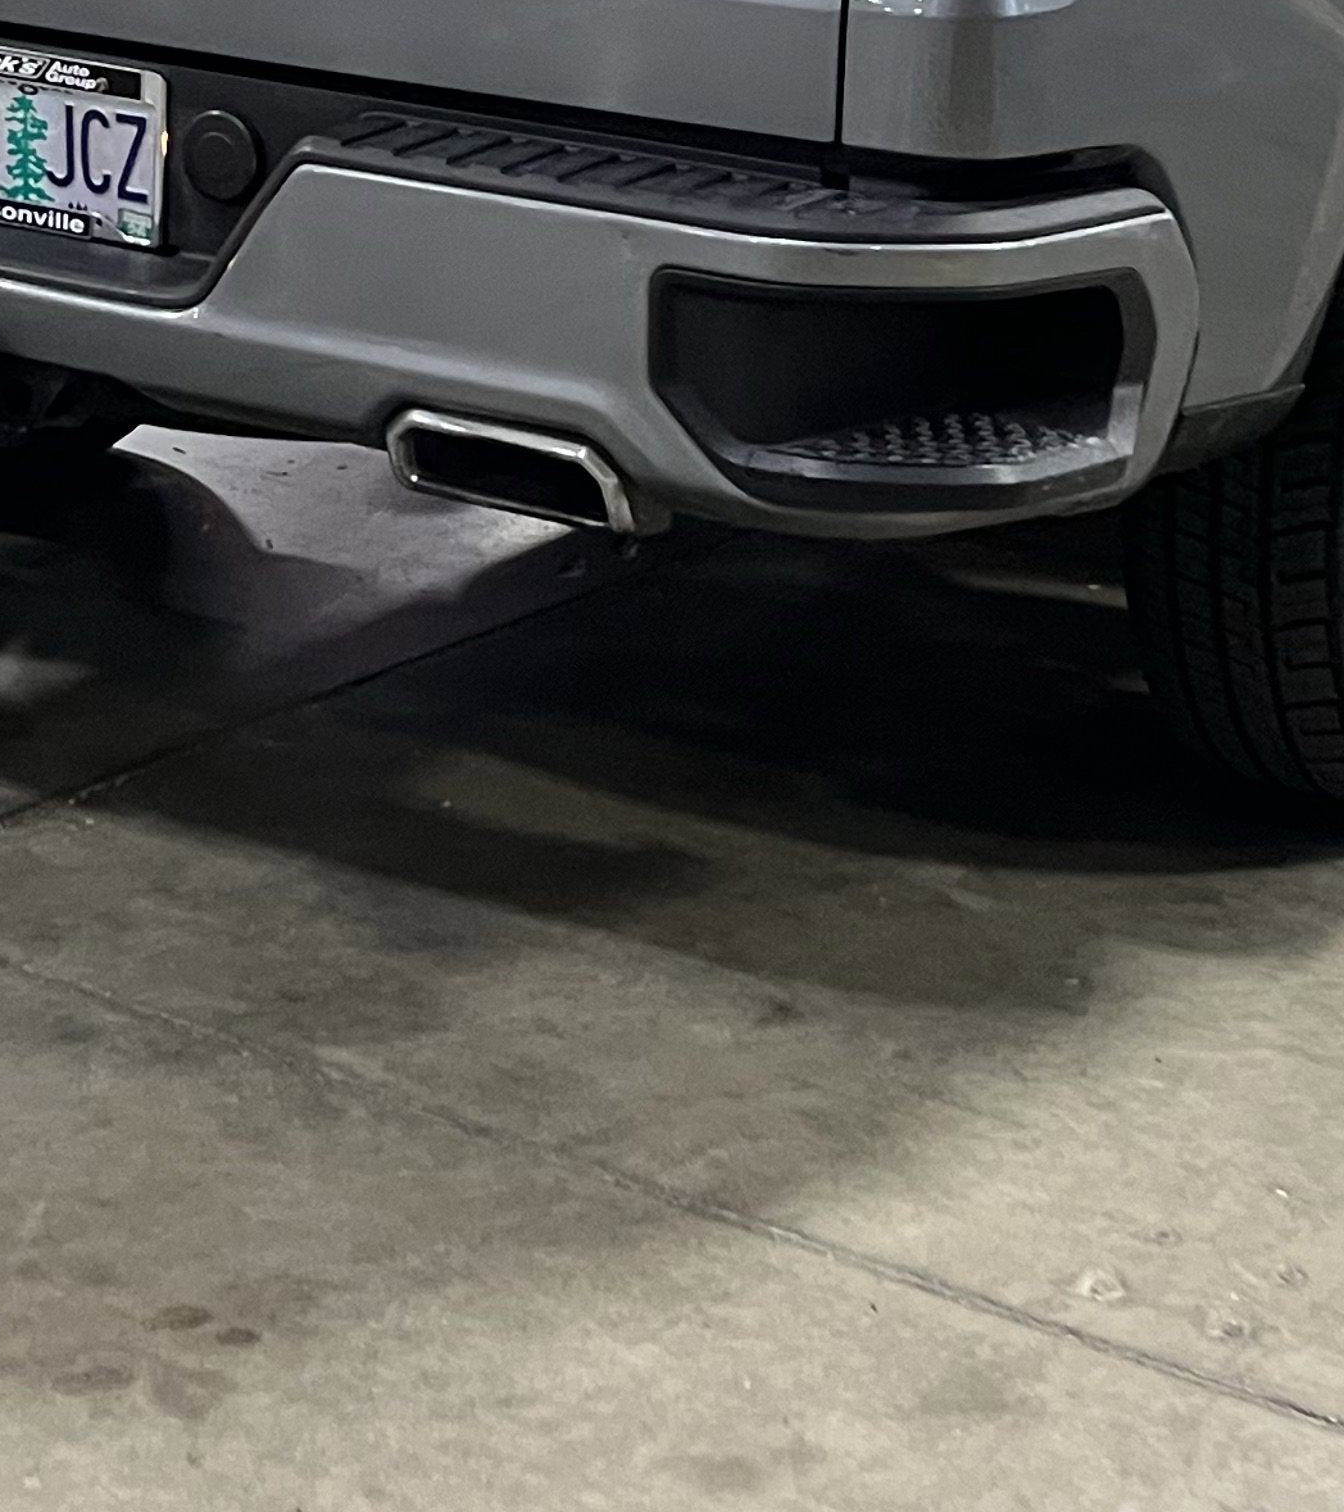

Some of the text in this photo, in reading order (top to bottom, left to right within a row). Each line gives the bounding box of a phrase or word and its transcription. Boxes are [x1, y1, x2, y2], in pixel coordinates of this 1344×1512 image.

[48, 61, 90, 78] Auto
[46, 71, 97, 90] Group
[46, 103, 149, 205] JCZ
